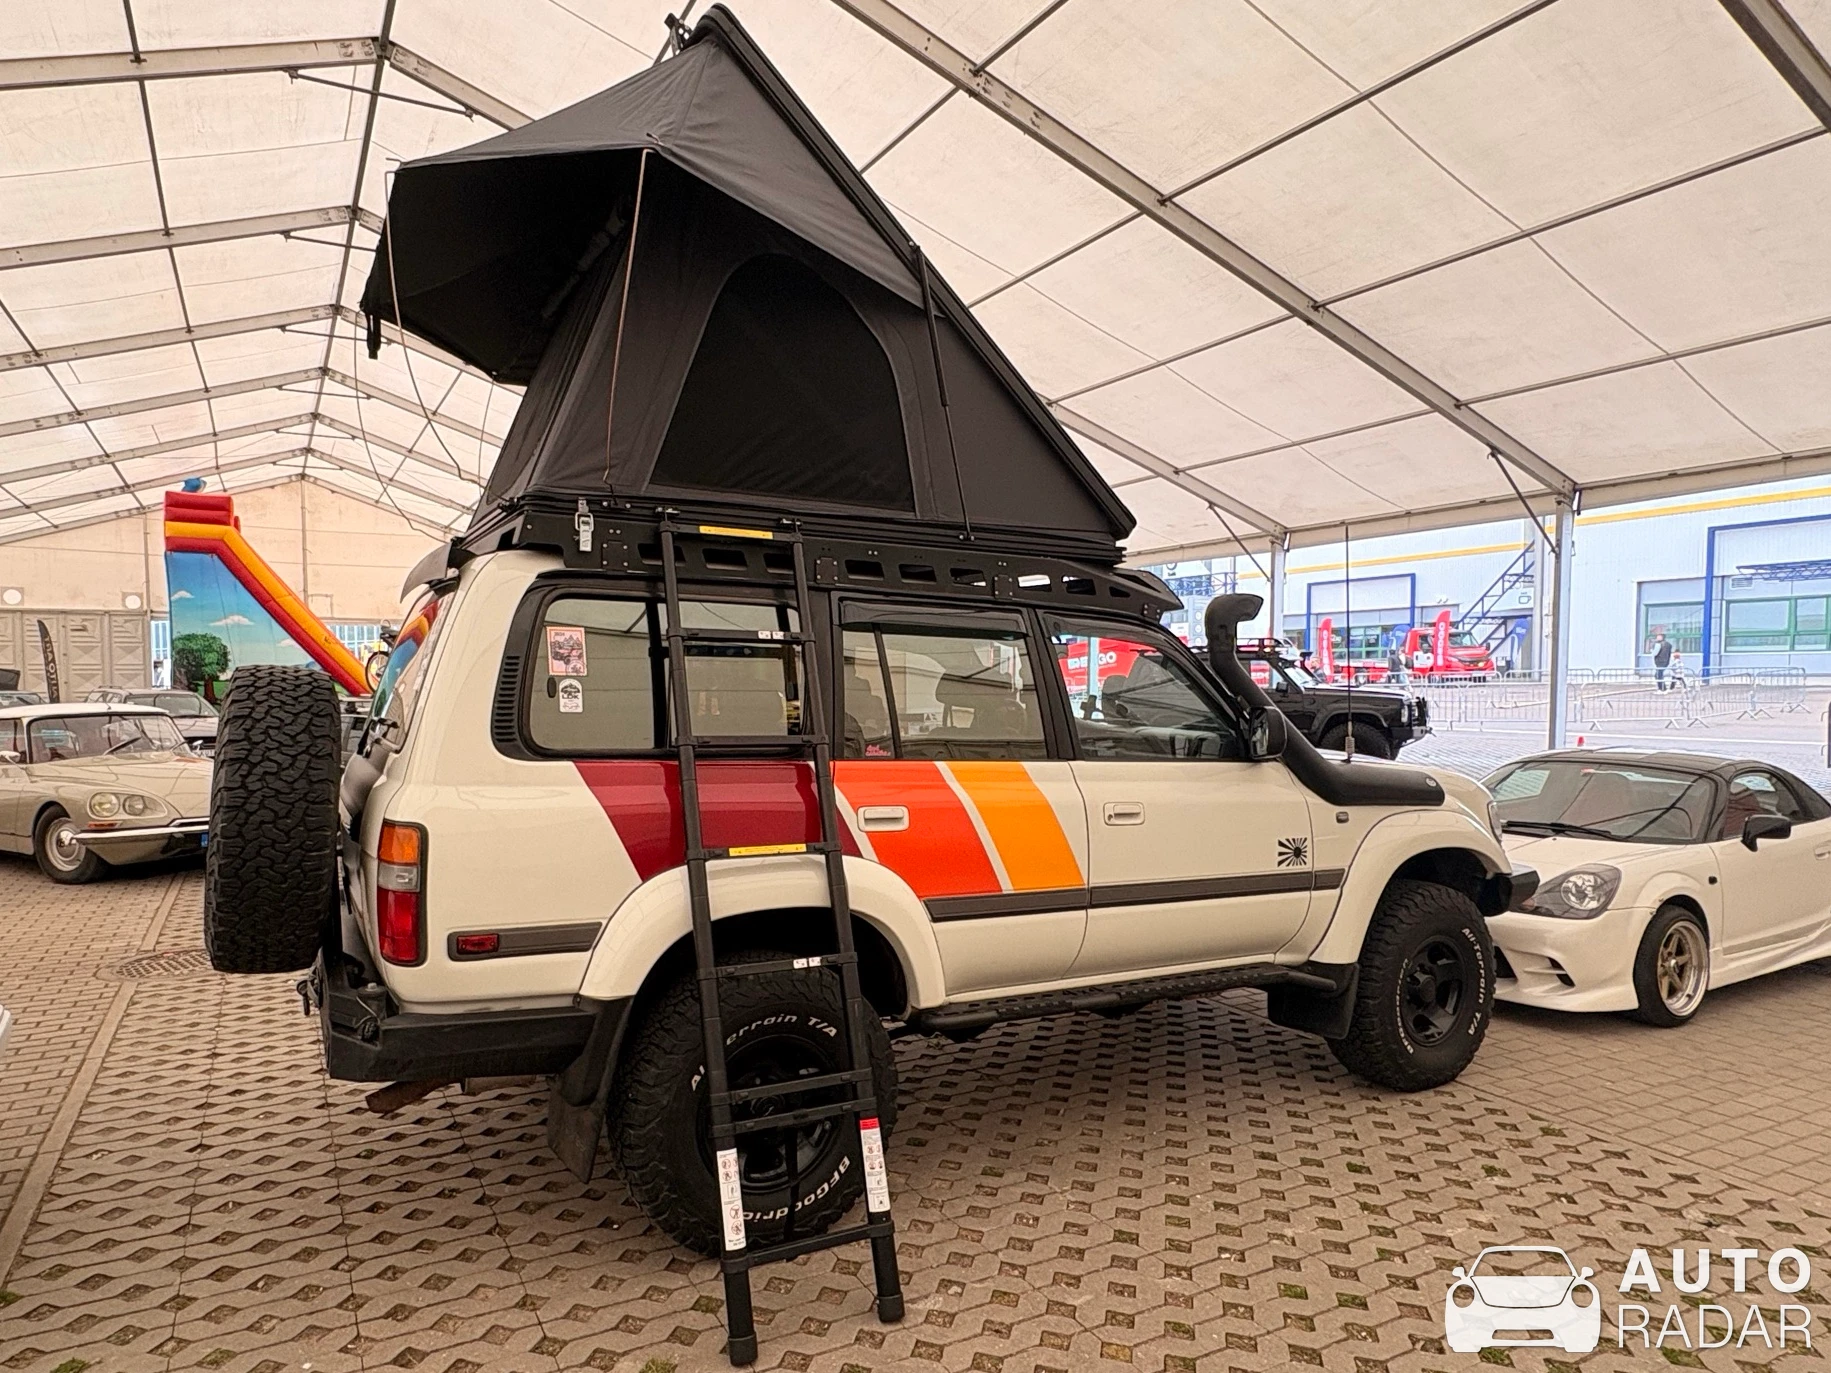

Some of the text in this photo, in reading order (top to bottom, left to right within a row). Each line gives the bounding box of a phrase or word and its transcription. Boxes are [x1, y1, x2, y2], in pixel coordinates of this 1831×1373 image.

[1067, 651, 1117, 670] REGO
[1462, 928, 1486, 1035] All-Terrain T/A
[808, 1016, 837, 1038] T/A
[743, 1155, 851, 1223] BFGoodric
